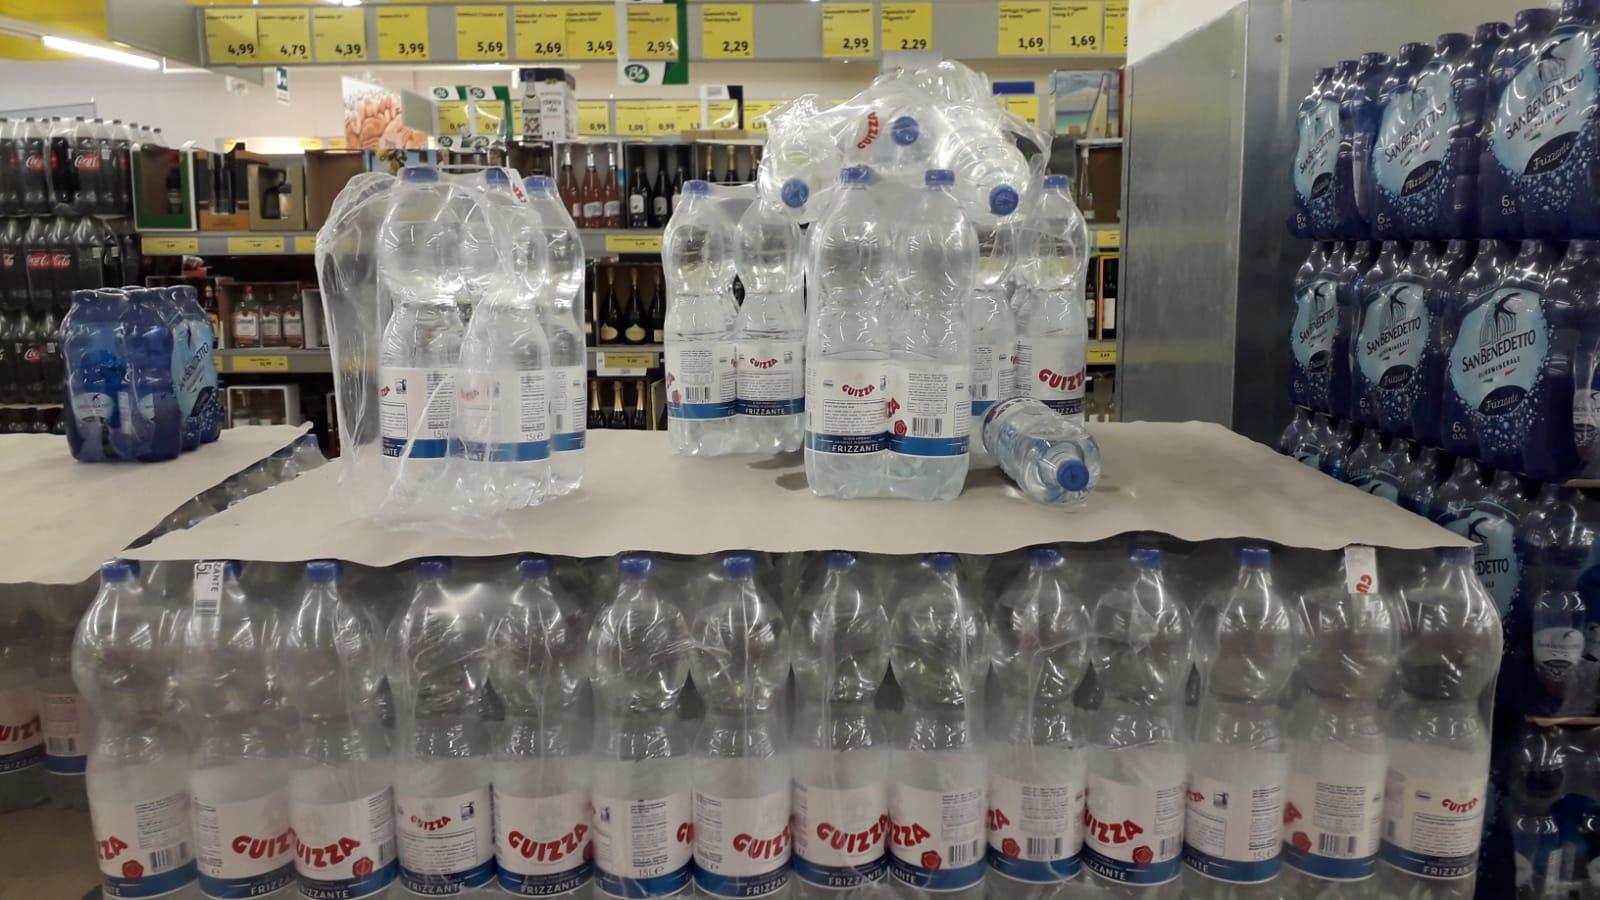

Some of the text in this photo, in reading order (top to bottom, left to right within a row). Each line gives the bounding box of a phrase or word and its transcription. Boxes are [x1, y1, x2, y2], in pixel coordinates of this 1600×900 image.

[477, 41, 503, 54] 5,69
[586, 41, 613, 54] 3,49
[647, 41, 673, 54] 2,99
[722, 40, 749, 53] 2,29
[843, 37, 869, 50] 2,99
[901, 38, 927, 50] 2,29
[1018, 37, 1044, 50] 1,69
[1071, 35, 1096, 48] 1,69
[228, 43, 255, 57] 4,99
[280, 44, 306, 57] 4,79
[335, 44, 361, 57] 4,39
[399, 43, 425, 56] 3,99
[535, 42, 562, 55] 2,69
[857, 112, 879, 149] GUIZZA
[749, 357, 779, 369] GUIZZA
[841, 383, 876, 398] GUIZZA
[745, 407, 785, 416] FRIZZANTE
[832, 443, 880, 454] FRIZZANTE
[1441, 797, 1478, 814] GUIZZA
[816, 814, 891, 854] GUIZZA
[508, 823, 589, 862] GUIZZA
[408, 880, 465, 895] FRIZZANTE
[521, 876, 580, 895] FRIZZANTE
